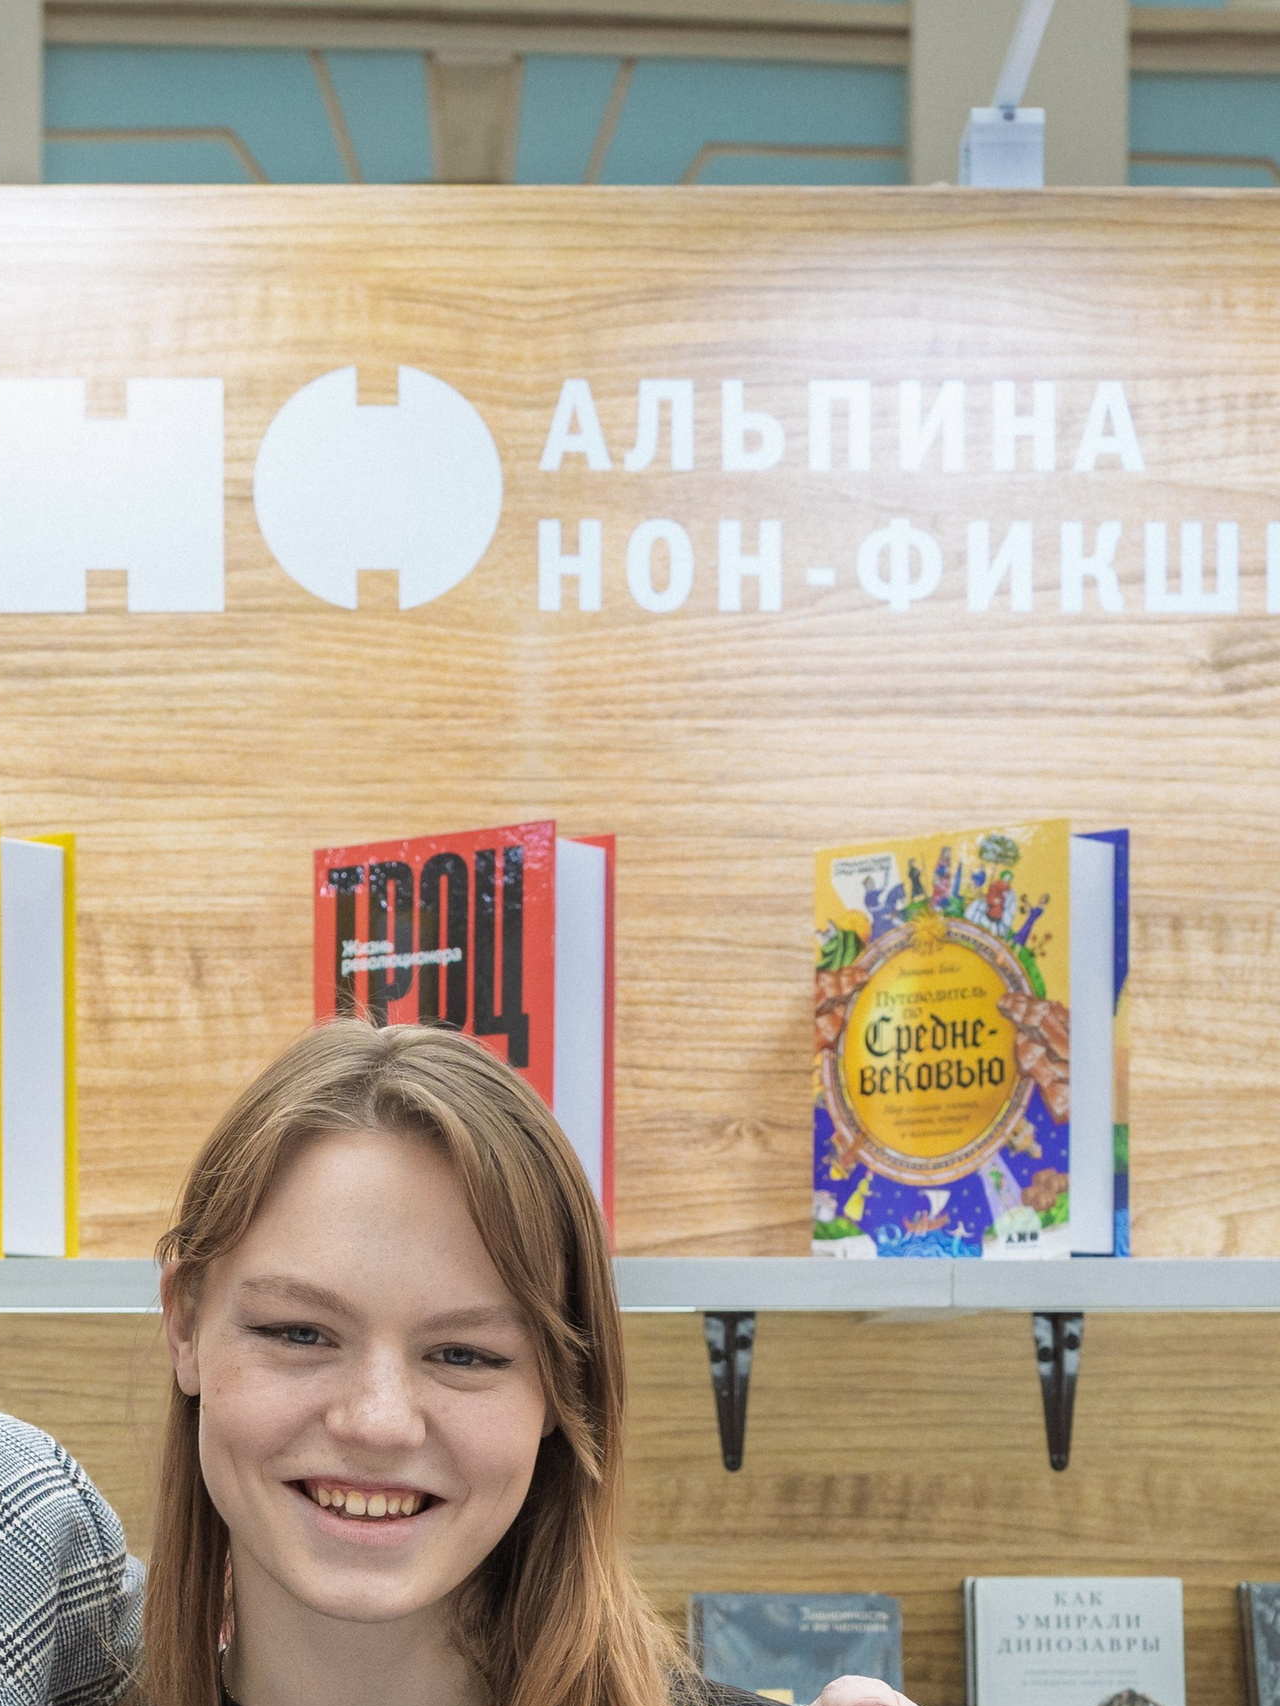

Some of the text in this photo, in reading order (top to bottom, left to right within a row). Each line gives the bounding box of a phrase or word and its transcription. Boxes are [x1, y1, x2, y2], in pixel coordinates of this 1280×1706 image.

[538, 378, 1146, 473] АЛЬПИНА
[537, 518, 1280, 614] НОН-ФИКШ
[865, 1014, 998, 1061] Средне-
[860, 1057, 1005, 1096] вековью
[1053, 1591, 1103, 1606] КАК
[1016, 1613, 1142, 1630] УМИРАЛИ
[997, 1636, 1160, 1655] ДИНОЗАВРЫ
